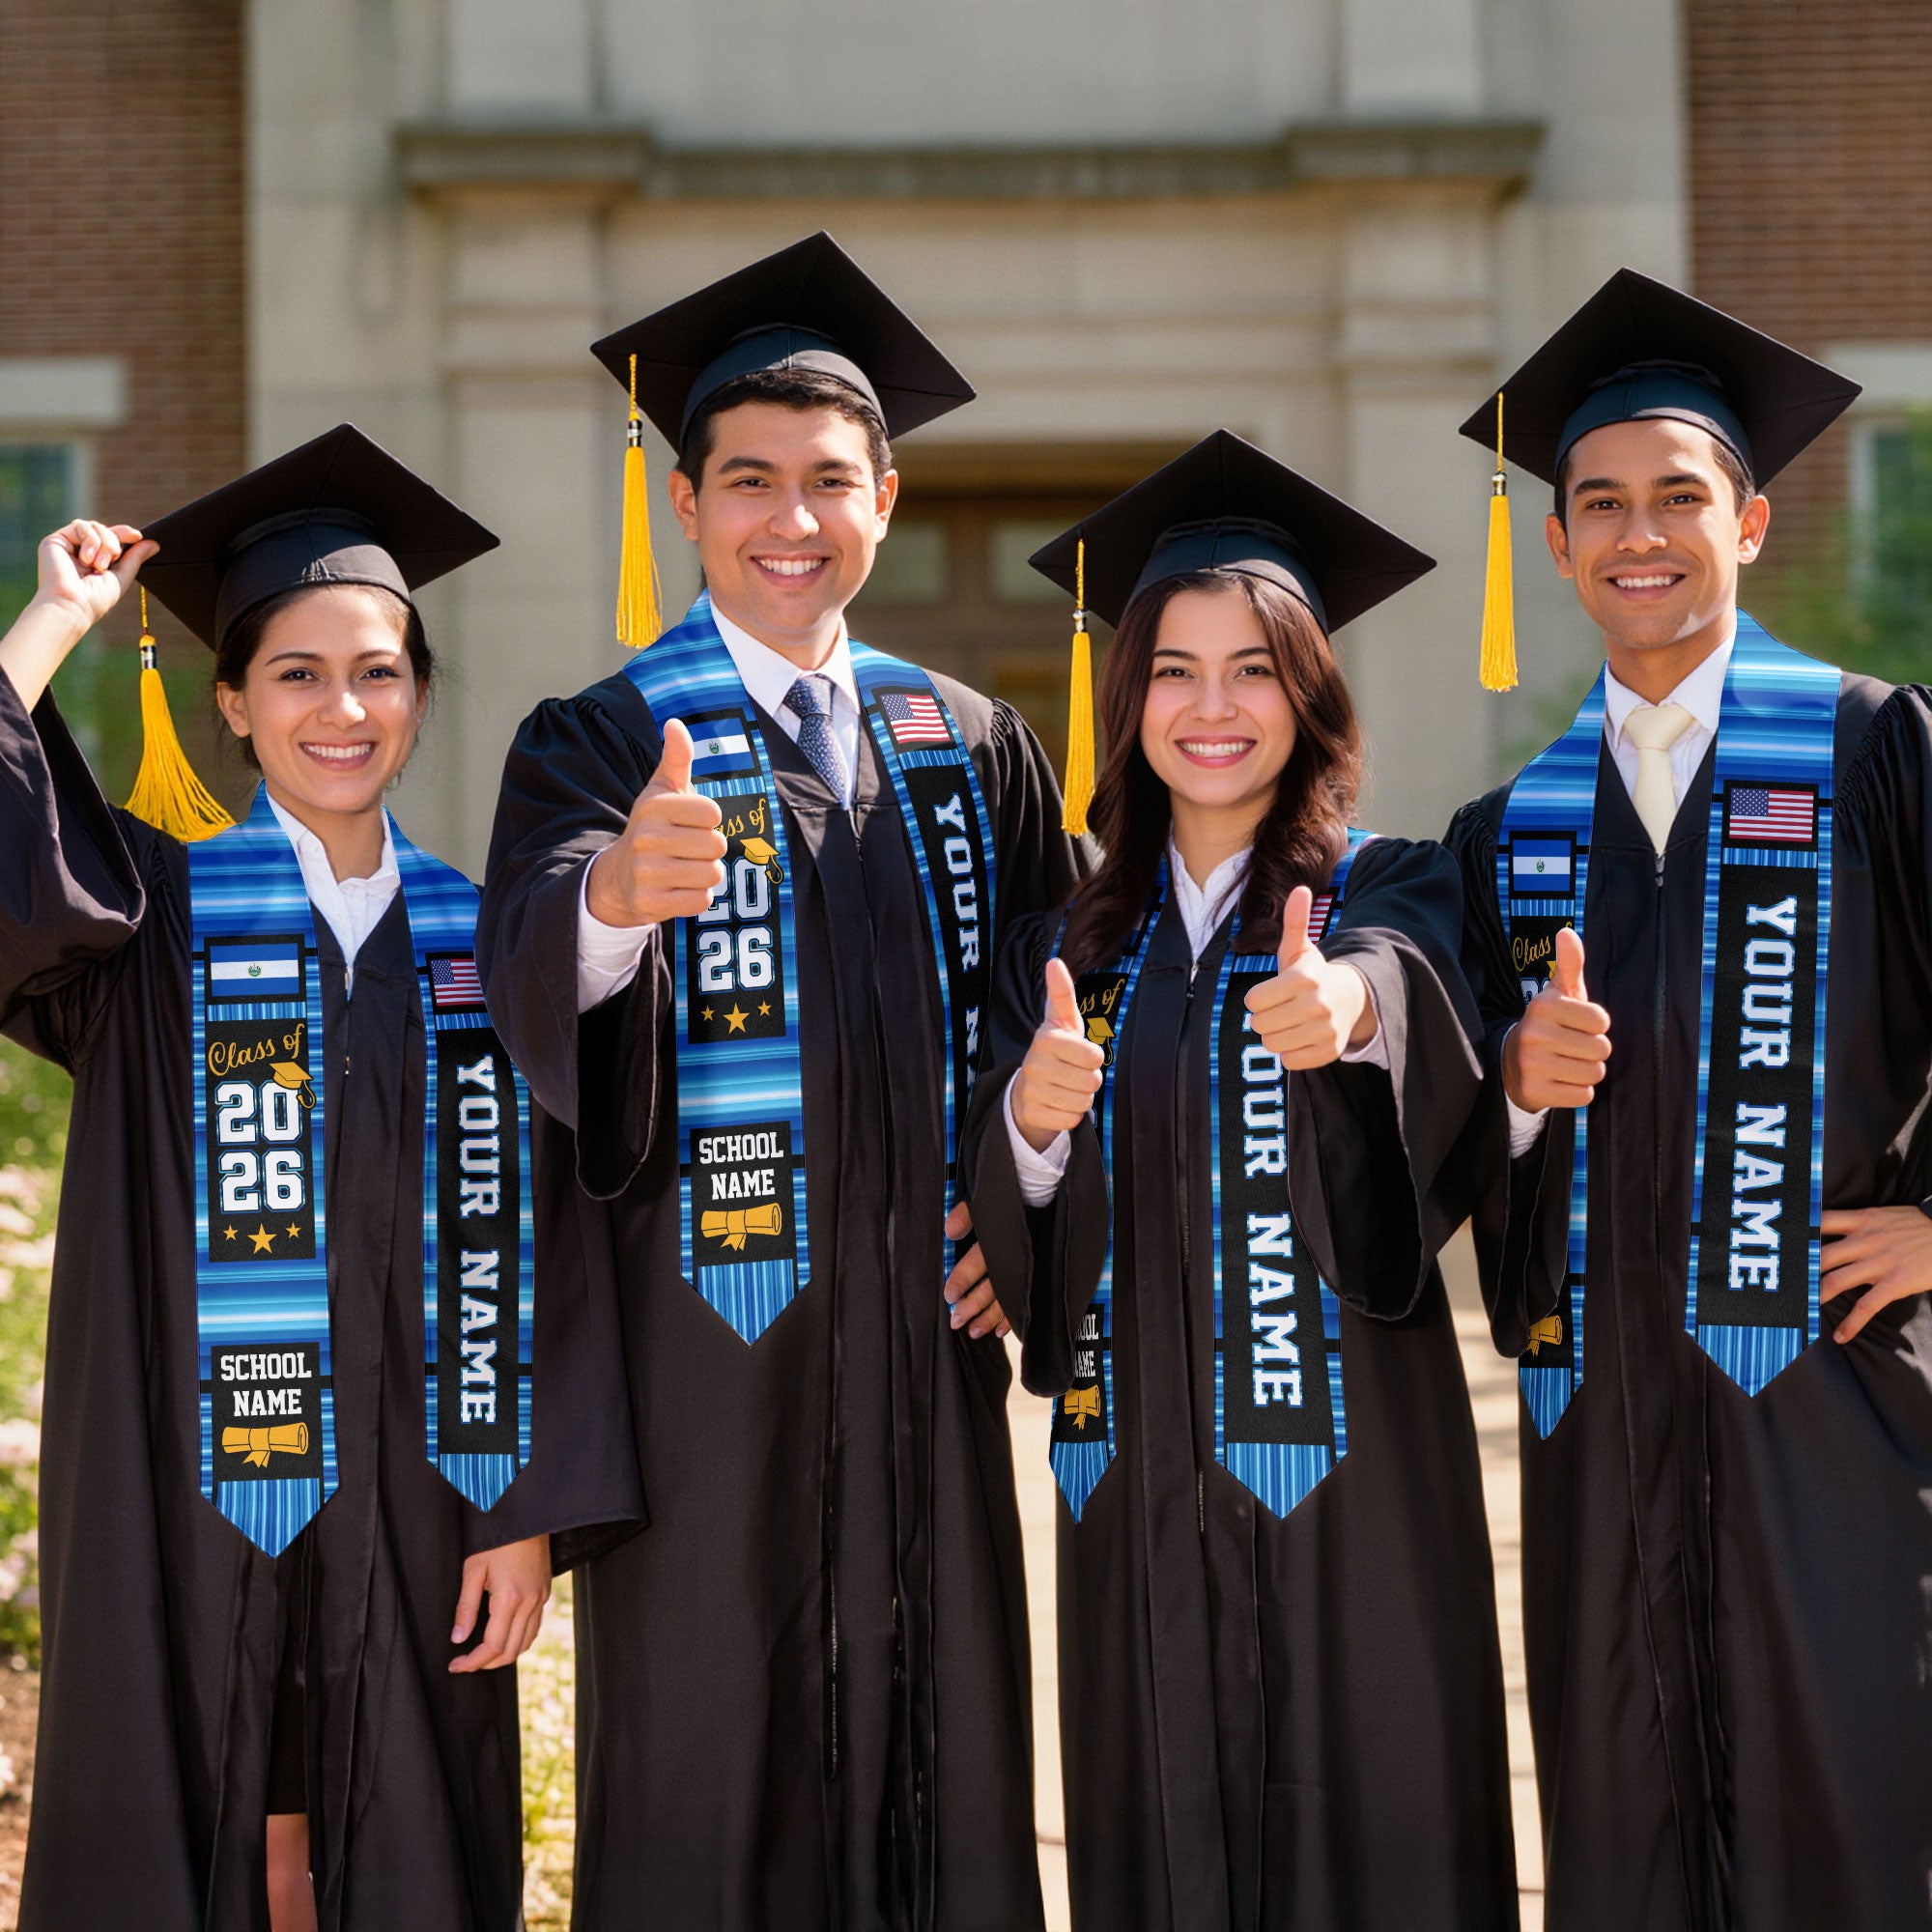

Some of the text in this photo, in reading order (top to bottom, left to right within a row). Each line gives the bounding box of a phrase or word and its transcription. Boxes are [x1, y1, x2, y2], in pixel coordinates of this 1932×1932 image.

[749, 798, 766, 835] of
[933, 792, 980, 973] YOUR
[696, 923, 775, 995] 26
[1512, 935, 1551, 973] Class
[1101, 978, 1125, 1015] of
[208, 1023, 305, 1077] Class of
[214, 1080, 303, 1146] 20
[1728, 895, 1797, 1293] YOUR NAME
[698, 1130, 784, 1165] SCHOOL
[218, 1148, 306, 1214] 26
[711, 1169, 776, 1201] NAME
[1241, 1010, 1303, 1408] OUR NAME
[458, 1055, 502, 1425] YOUR NAME
[220, 1352, 312, 1381] SCHOOL
[234, 1387, 303, 1416] NAME
